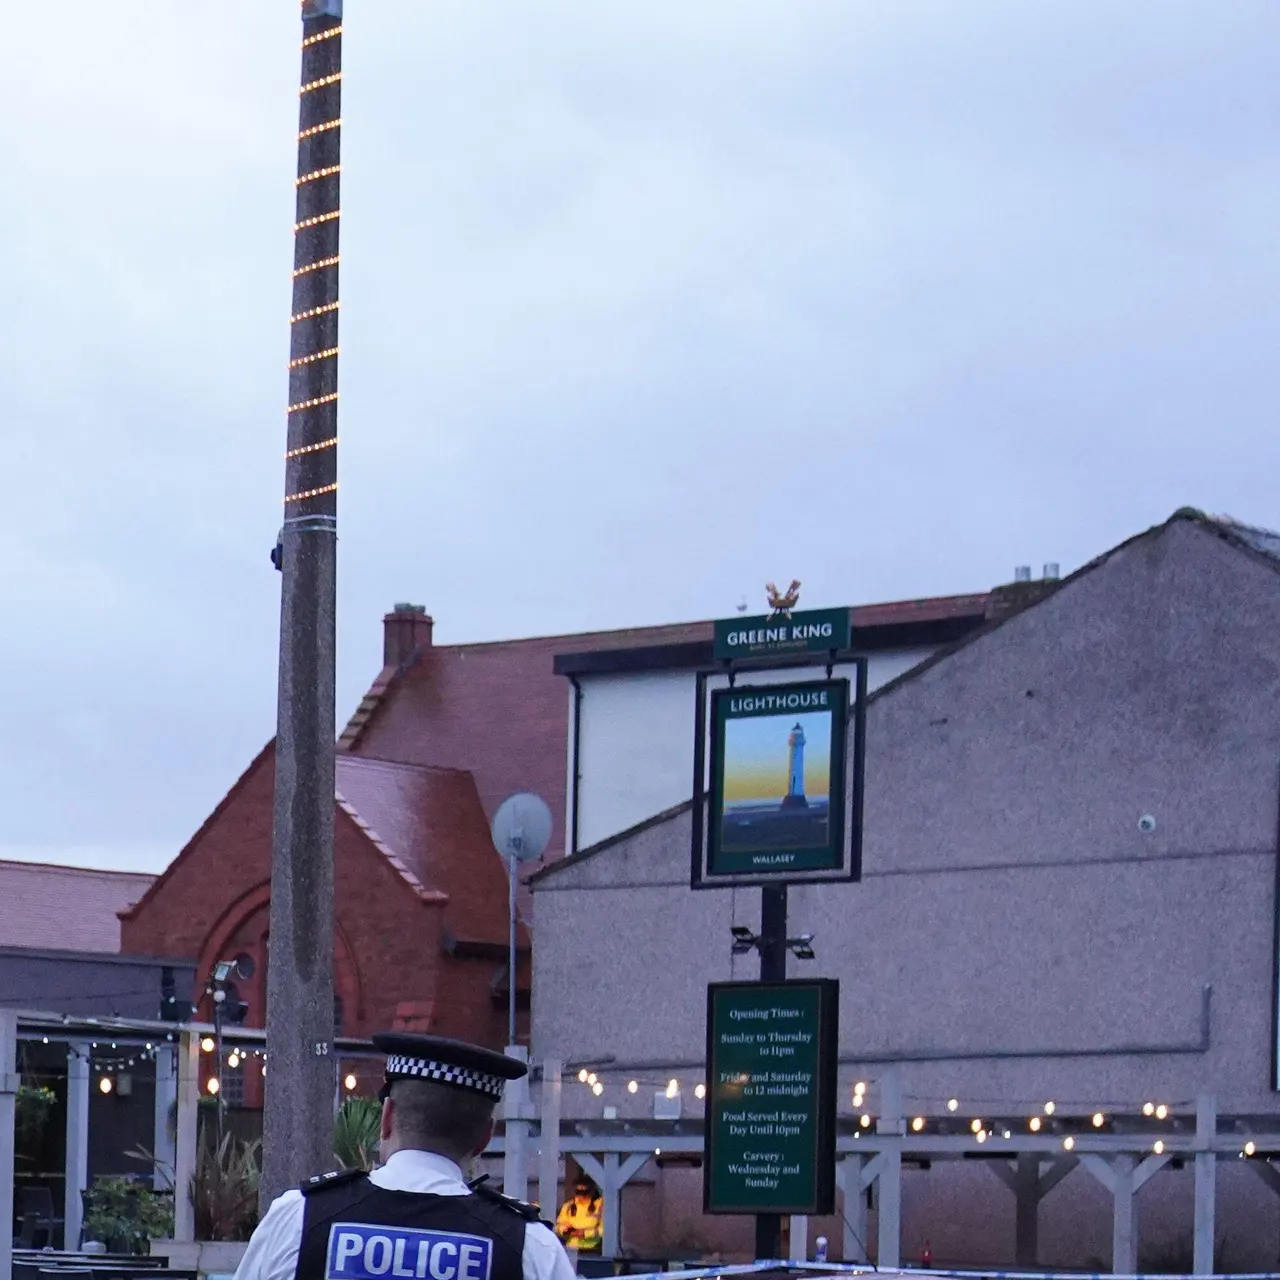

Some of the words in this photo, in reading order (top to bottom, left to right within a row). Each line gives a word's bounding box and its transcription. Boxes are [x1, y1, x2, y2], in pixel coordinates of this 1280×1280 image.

[727, 627, 787, 646] GREENE
[792, 622, 832, 640] KING
[730, 690, 828, 713] LIGHTHOUSE
[729, 1009, 768, 1021] Opening
[721, 1032, 755, 1044] Sunday
[756, 1034, 766, 1042] to
[768, 1030, 812, 1044] Thursday
[760, 1046, 769, 1056] to
[751, 1072, 769, 1083] and
[770, 1071, 812, 1084] Saturday
[744, 1087, 754, 1096] to
[755, 1085, 765, 1096] 12
[767, 1084, 809, 1097] midnight
[722, 1110, 746, 1121] Food
[747, 1111, 779, 1122] Served
[781, 1111, 808, 1123] Every
[729, 1124, 748, 1137] Day
[750, 1124, 773, 1135] Until
[728, 1163, 781, 1176] Wednesday
[782, 1163, 800, 1174] and
[744, 1176, 779, 1190] Sunday
